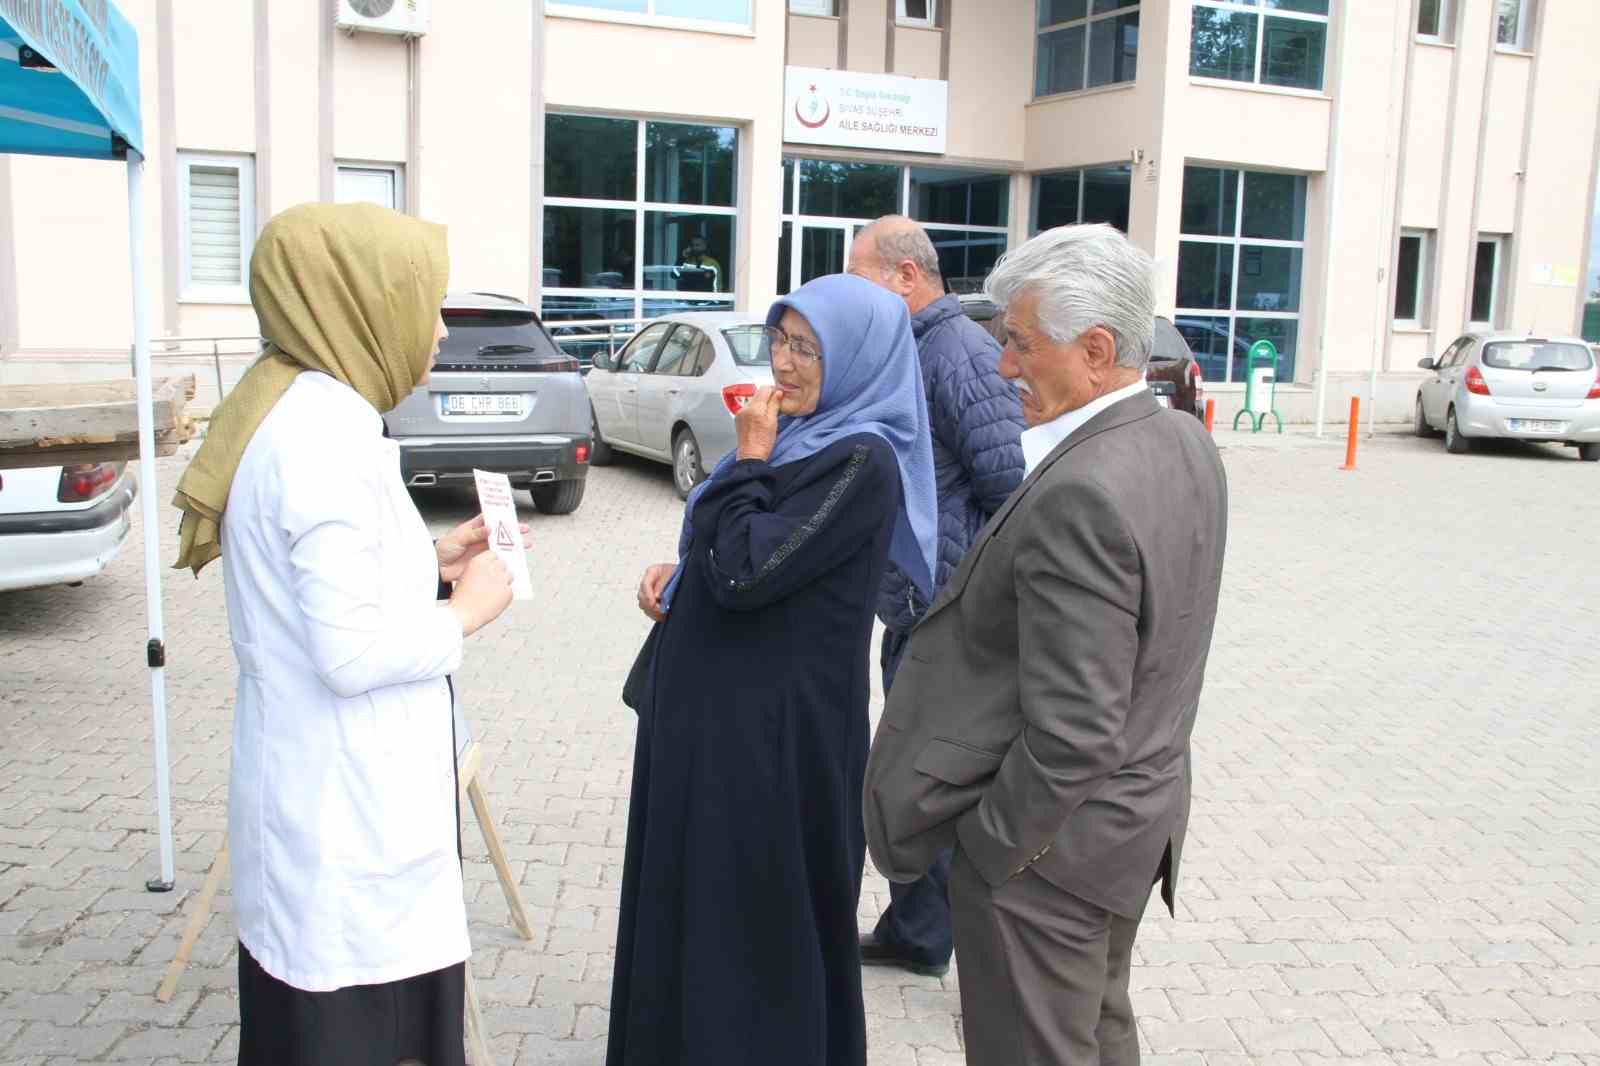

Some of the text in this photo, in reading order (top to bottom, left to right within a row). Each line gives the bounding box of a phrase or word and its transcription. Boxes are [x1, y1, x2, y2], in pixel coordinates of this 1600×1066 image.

[839, 119, 938, 137] AİLE SAĞLIĞI MERKEZİ
